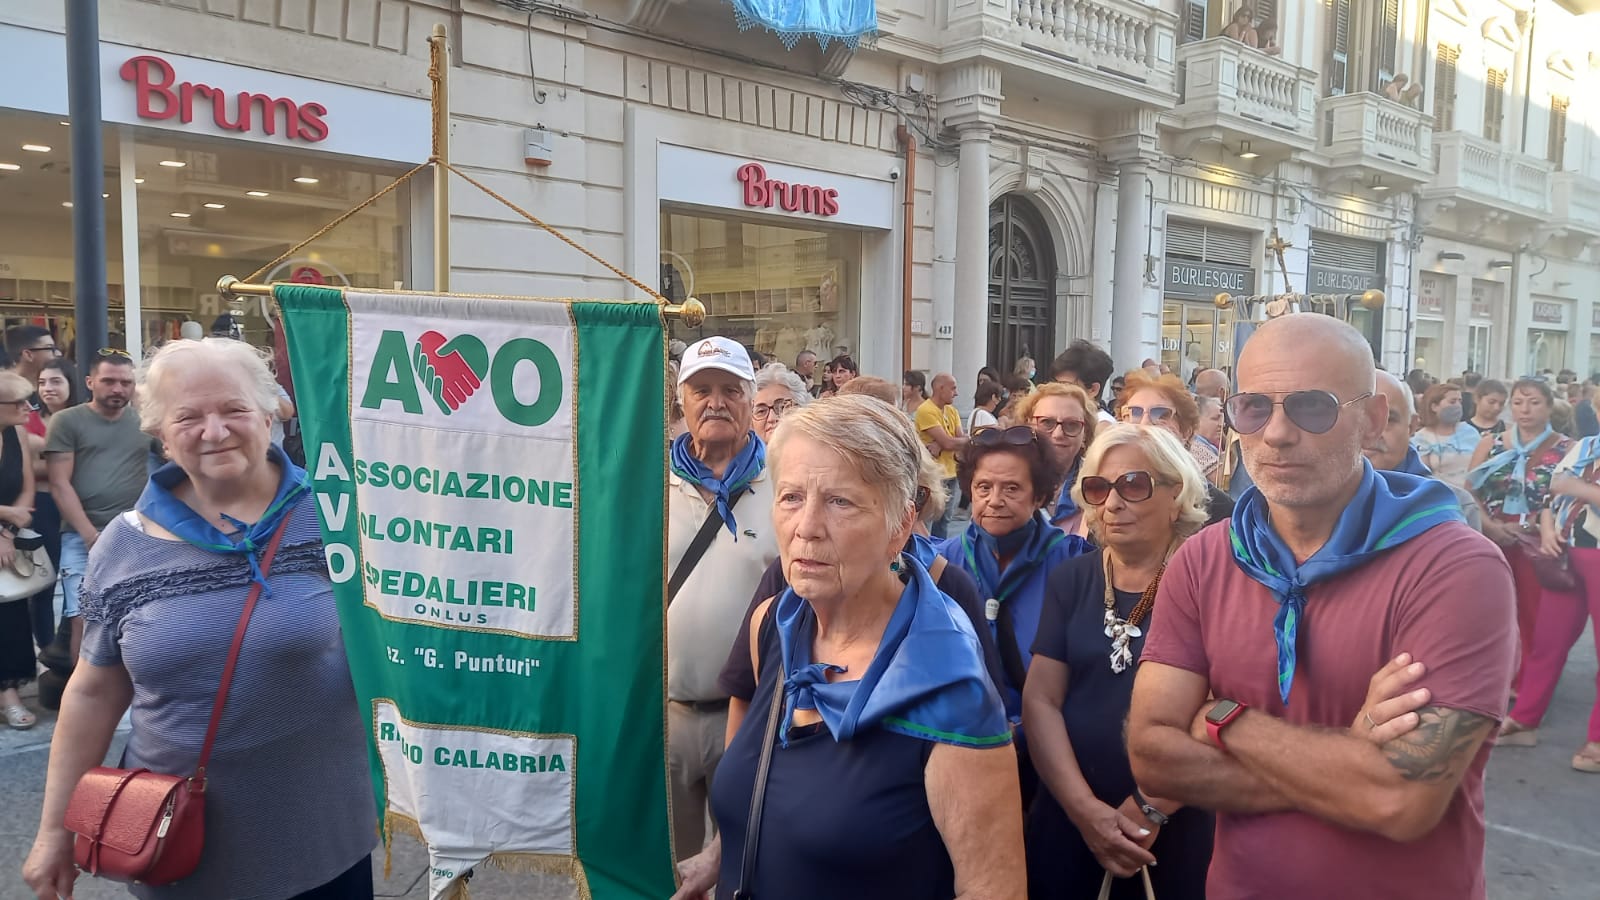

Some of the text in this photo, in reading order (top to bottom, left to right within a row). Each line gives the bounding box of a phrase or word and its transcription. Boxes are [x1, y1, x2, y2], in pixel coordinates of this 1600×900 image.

[119, 55, 329, 143] Brums
[737, 162, 839, 216] Brums
[1172, 266, 1244, 290] BURLESQUE
[1317, 271, 1372, 291] BURLESQUE
[414, 604, 487, 624] ONLUS
[414, 647, 444, 669] "G.
[455, 651, 540, 677] Punturi"
[434, 746, 566, 774] CALABRIA
